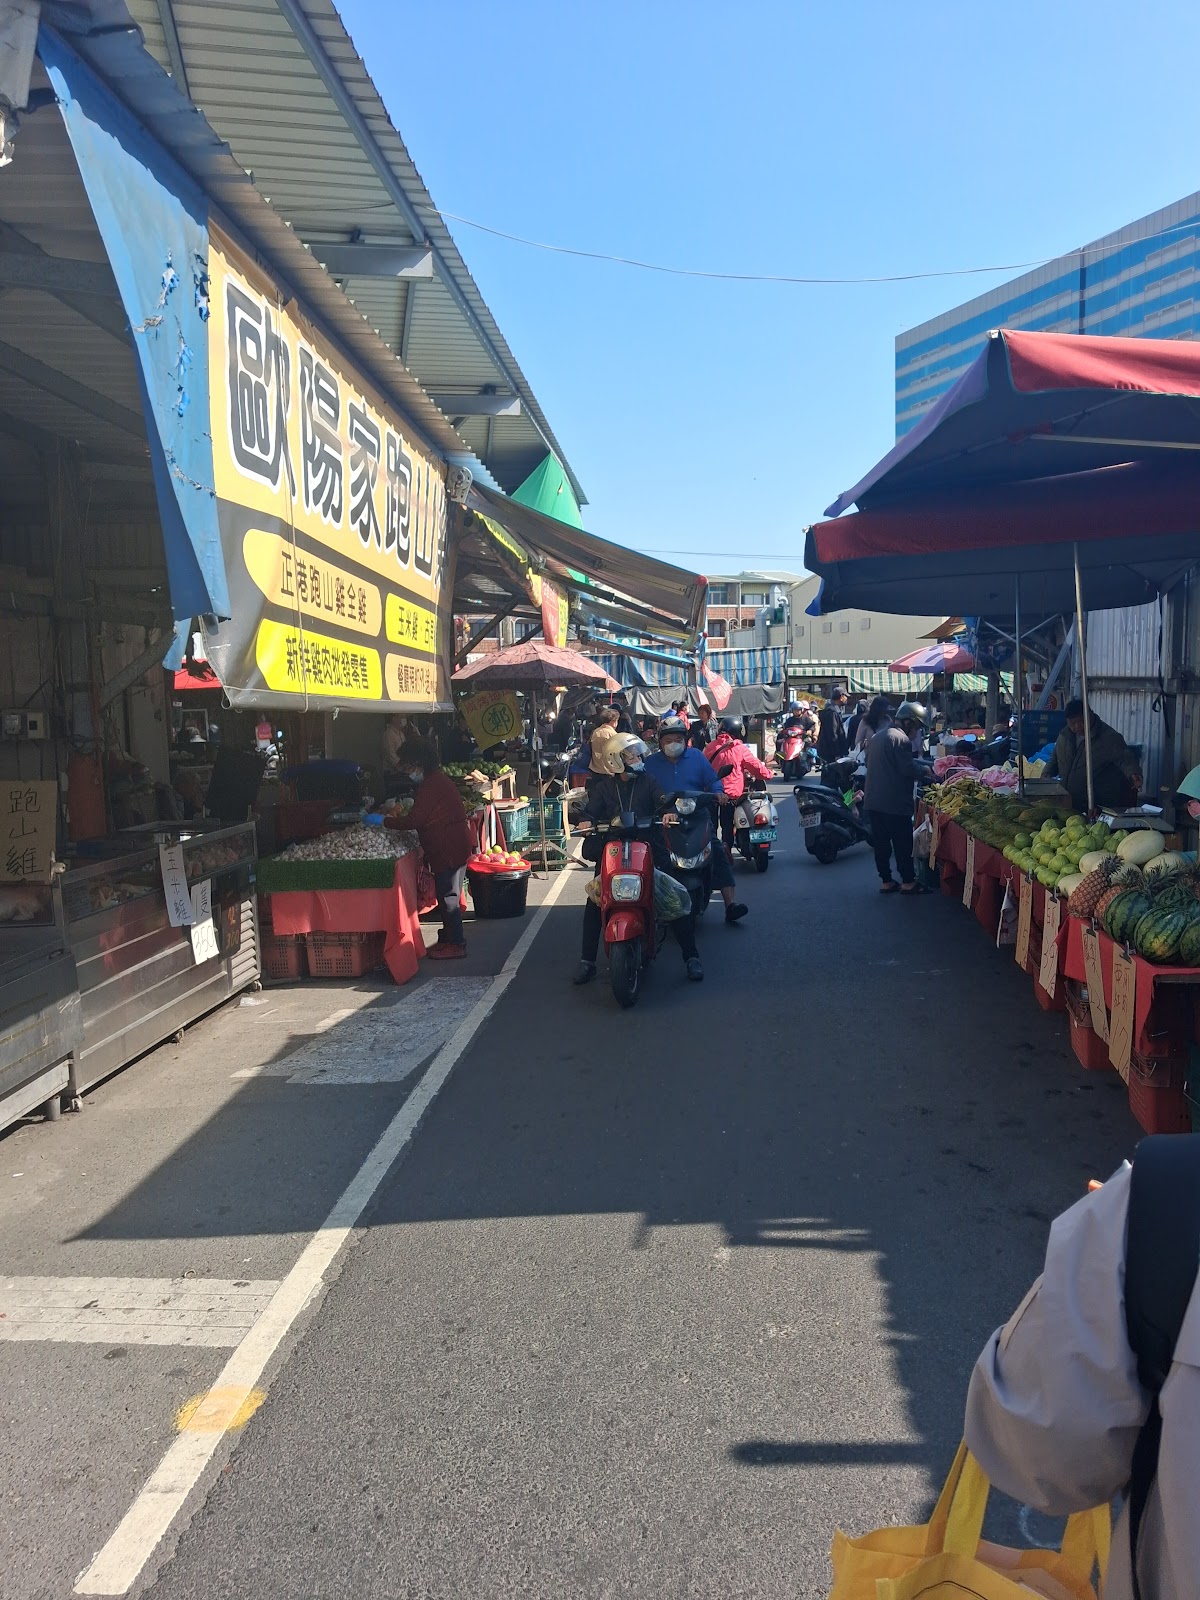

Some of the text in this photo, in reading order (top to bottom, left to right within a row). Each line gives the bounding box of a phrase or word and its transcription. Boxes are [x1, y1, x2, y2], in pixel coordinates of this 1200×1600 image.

[281, 551, 367, 624] 正港跑山雞全雞
[286, 635, 369, 689] 新鮮雞肉批發零售
[6, 788, 43, 876] 跑山雞
[193, 924, 215, 957] 350
